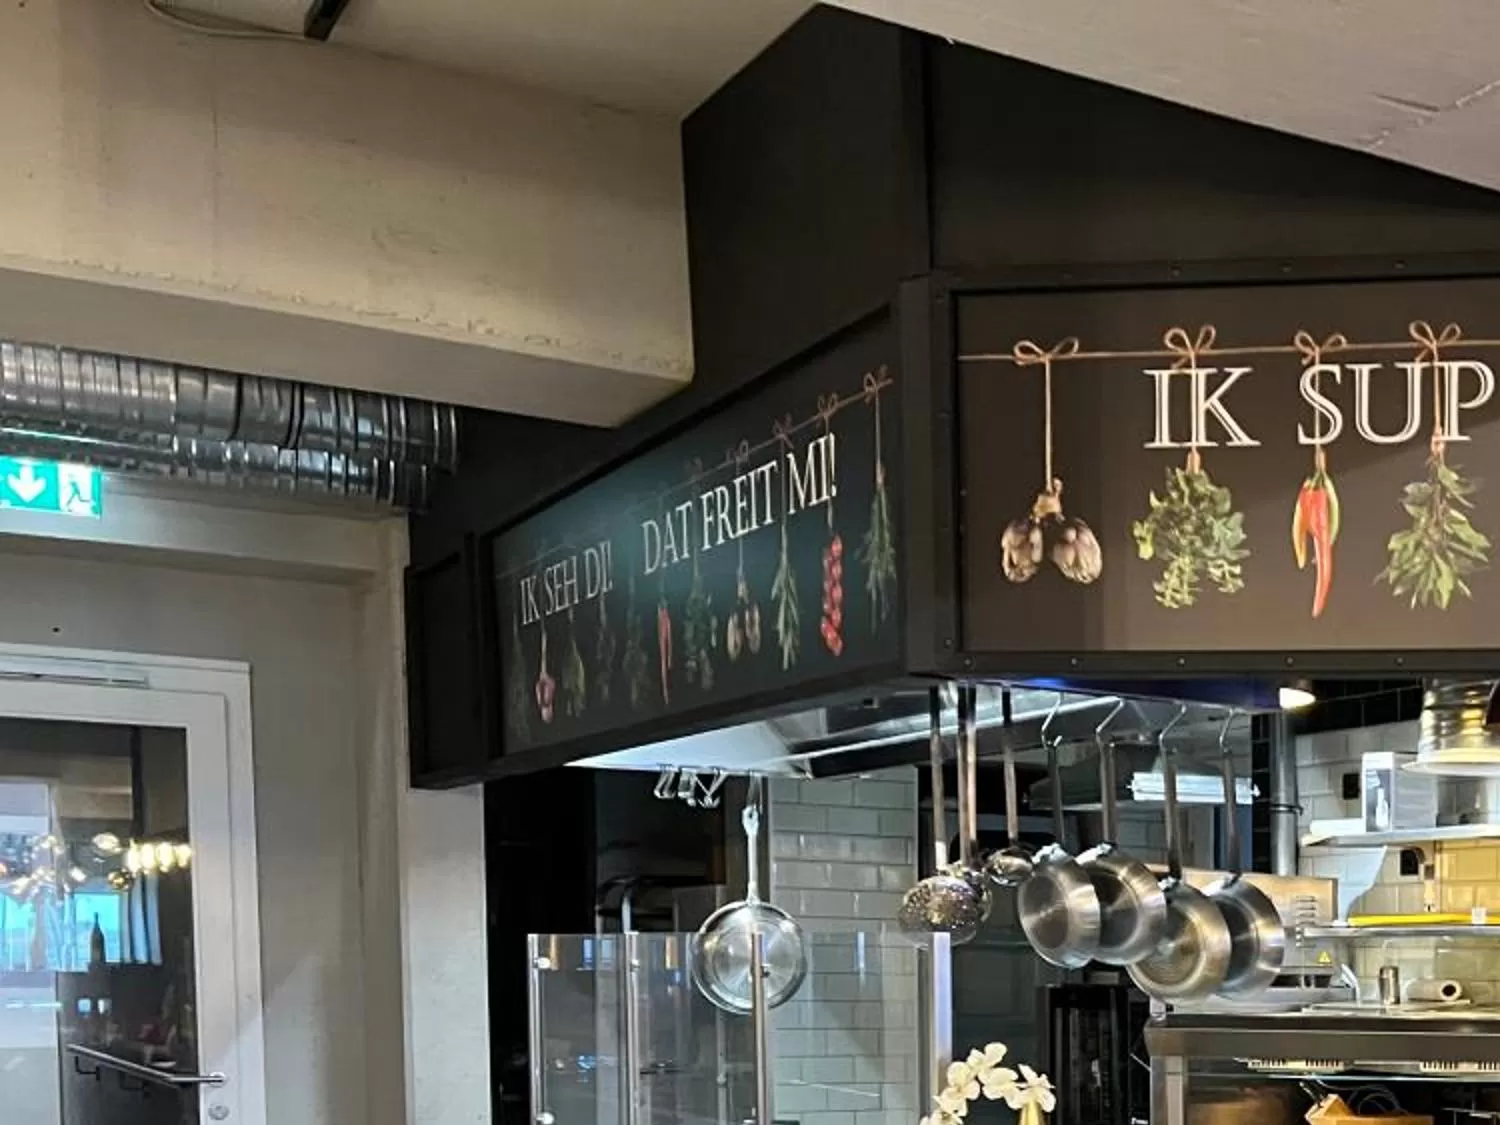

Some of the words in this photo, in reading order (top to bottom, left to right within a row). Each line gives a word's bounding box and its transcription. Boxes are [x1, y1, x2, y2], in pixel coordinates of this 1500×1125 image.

[1142, 366, 1261, 448] IK
[1298, 360, 1496, 446] SUP
[520, 576, 541, 626] IK
[544, 556, 579, 616] SEH
[584, 540, 613, 599] DI!
[642, 500, 693, 575] DAT
[700, 460, 778, 552] FREIT
[786, 433, 839, 516] MI!
